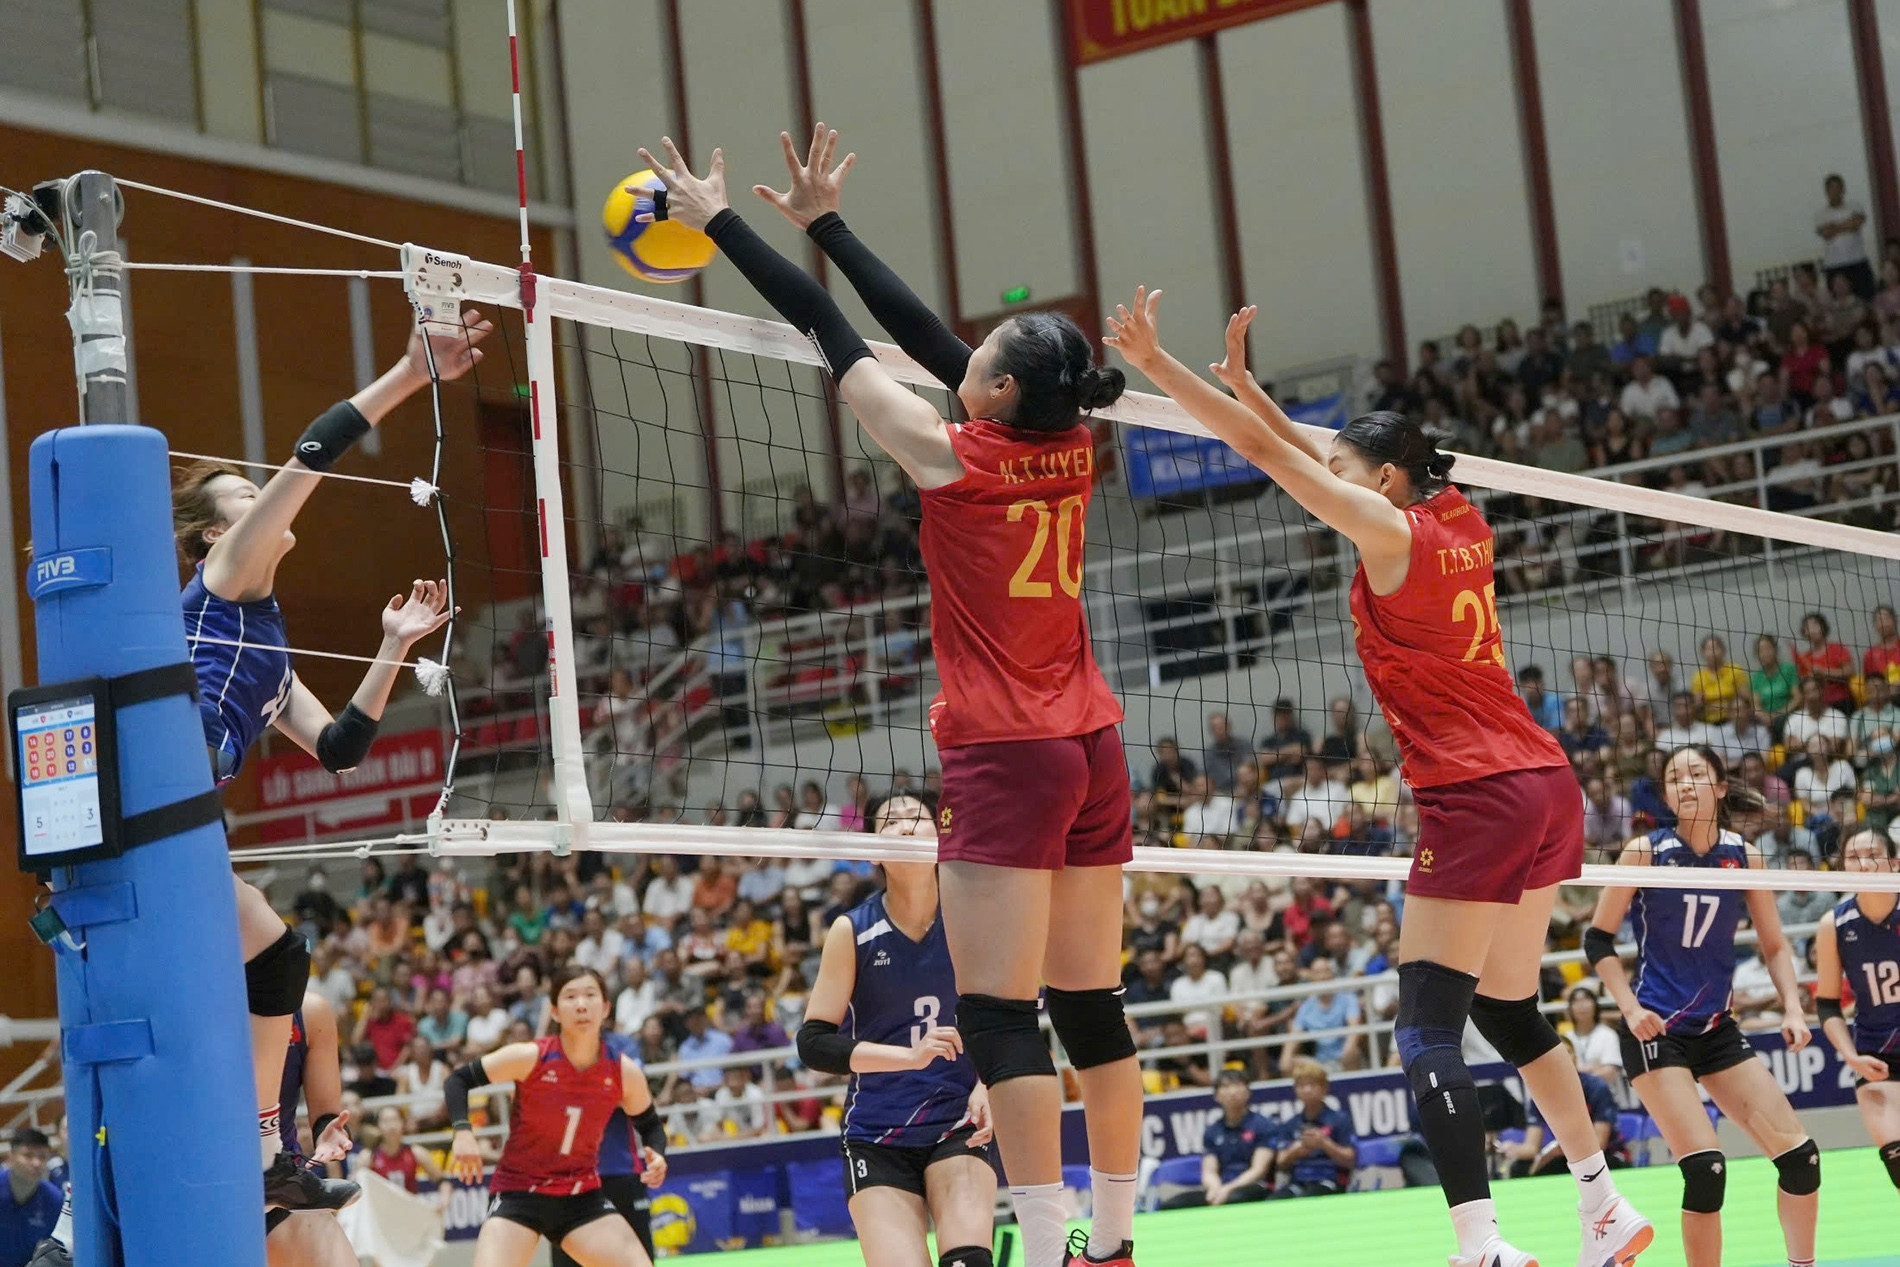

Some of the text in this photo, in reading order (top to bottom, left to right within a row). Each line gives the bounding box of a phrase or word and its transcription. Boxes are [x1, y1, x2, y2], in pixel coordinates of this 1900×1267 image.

[434, 256, 462, 269] Senoh
[1006, 495, 1085, 599] 20
[37, 555, 75, 582] FIVB
[36, 816, 43, 829] 5
[87, 807, 94, 820] 3
[1681, 894, 1720, 948] 17
[1862, 961, 1900, 1007] 12
[911, 996, 941, 1049] 3
[1645, 1041, 1658, 1060] 17
[560, 1106, 582, 1155] 1
[1348, 1089, 1411, 1137] VOL
[857, 1159, 868, 1178] 3
